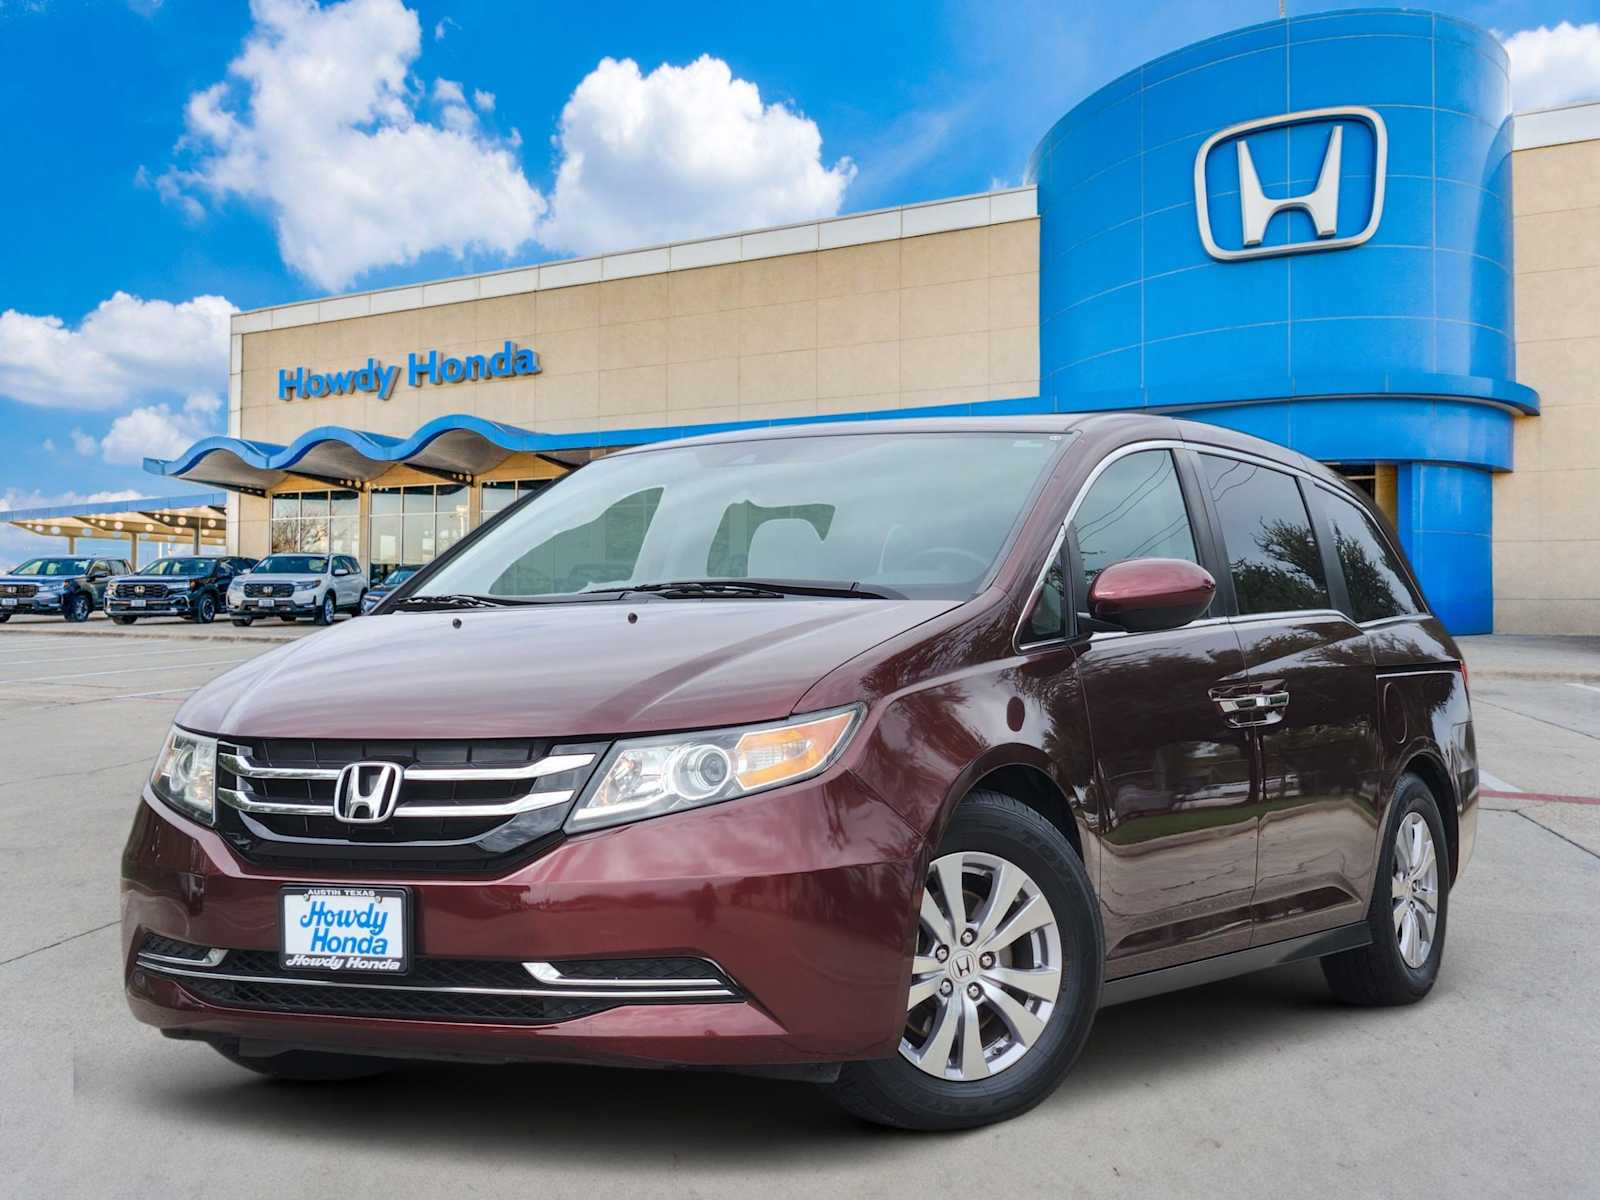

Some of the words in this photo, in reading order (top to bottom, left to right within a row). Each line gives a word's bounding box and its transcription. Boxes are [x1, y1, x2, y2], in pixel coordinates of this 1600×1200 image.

[278, 357, 401, 401] Howdy
[407, 340, 542, 388] Honda
[344, 889, 375, 897] TEXAS
[300, 901, 388, 935] Howdy
[310, 927, 388, 955] Honda
[285, 954, 344, 970] Howdy
[345, 957, 401, 970] Honda
